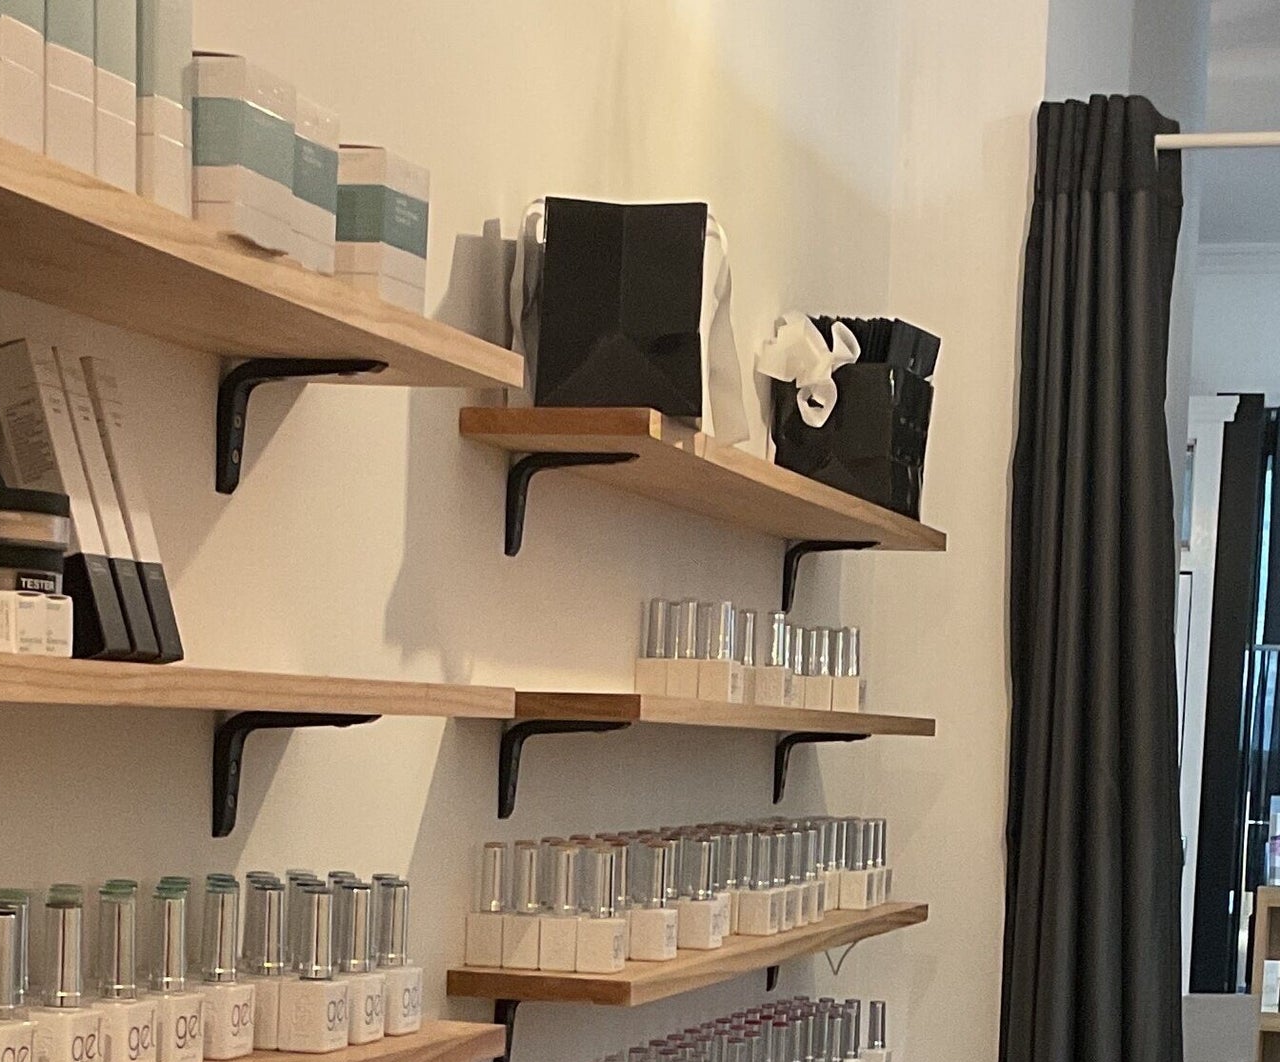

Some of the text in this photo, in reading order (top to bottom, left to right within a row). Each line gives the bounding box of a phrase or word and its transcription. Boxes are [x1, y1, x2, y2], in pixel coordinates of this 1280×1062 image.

[20, 577, 55, 591] TESTER
[176, 1000, 202, 1049] gel
[231, 989, 254, 1036] gel
[327, 985, 348, 1031] gel
[128, 1009, 155, 1060] gel
